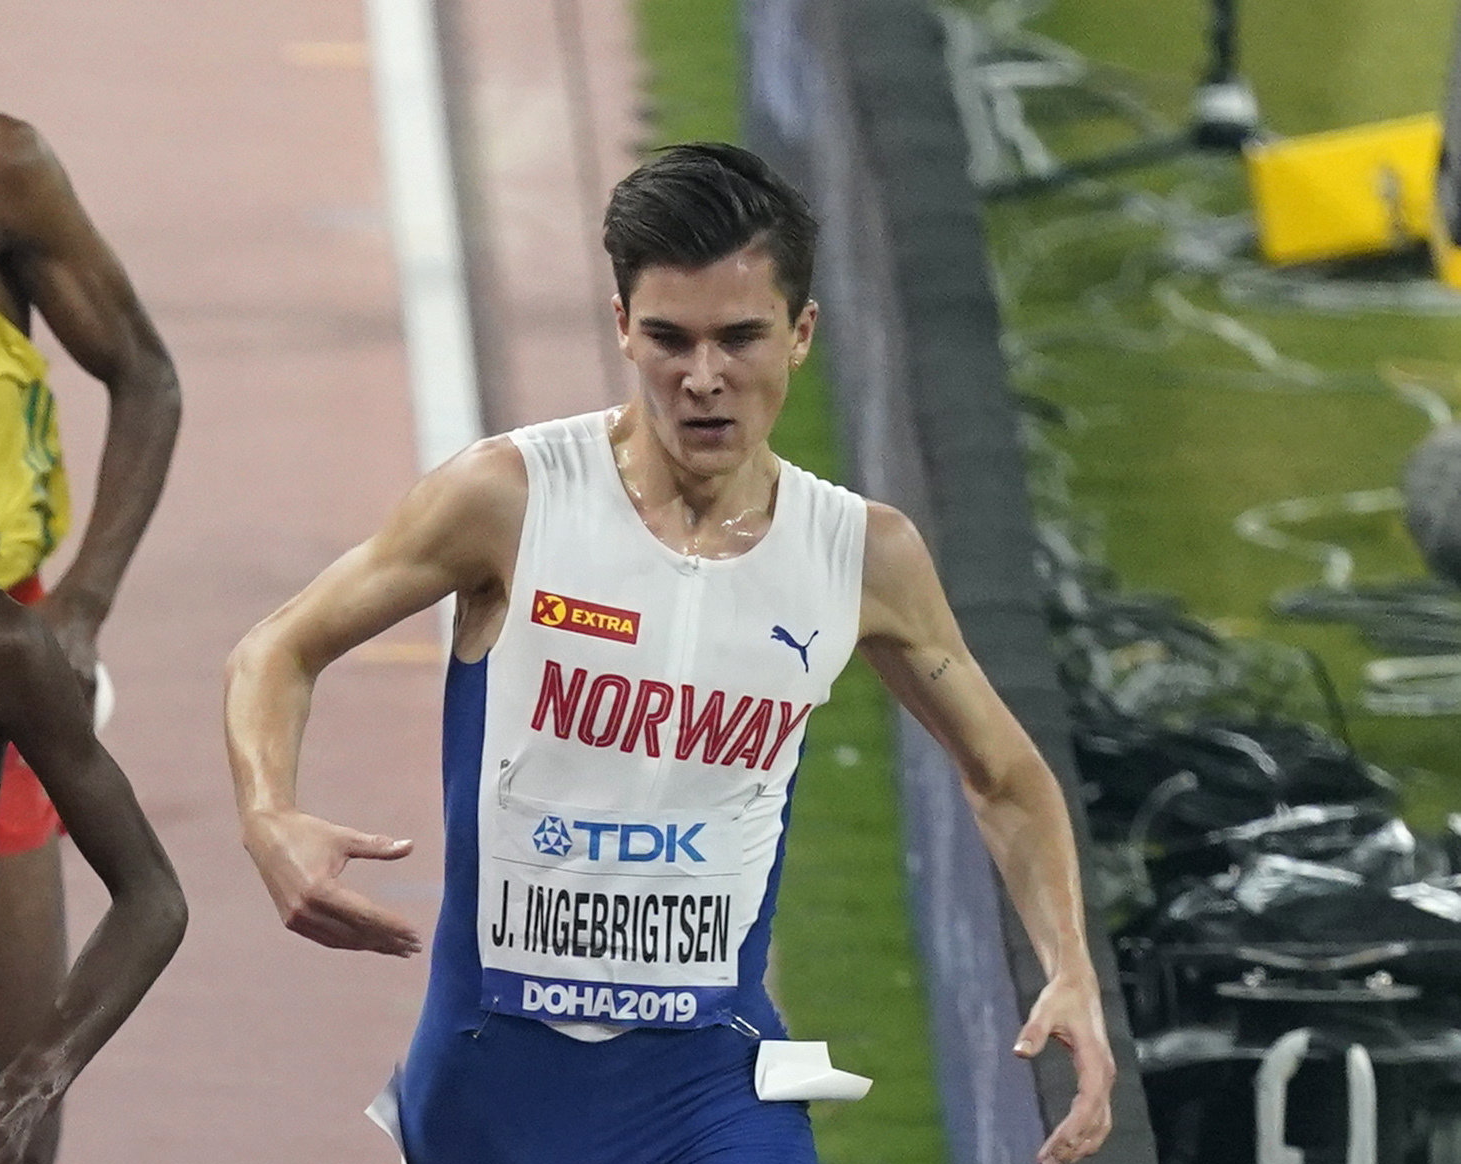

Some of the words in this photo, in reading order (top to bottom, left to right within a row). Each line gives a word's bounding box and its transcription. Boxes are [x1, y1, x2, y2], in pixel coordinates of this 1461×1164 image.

[571, 608, 634, 635] EXTRA
[531, 659, 812, 771] NORWAY
[573, 821, 708, 864] TDK
[492, 880, 514, 948] J.
[524, 884, 732, 964] INGEBRIGTSEN
[522, 980, 698, 1023] DOHA2019
